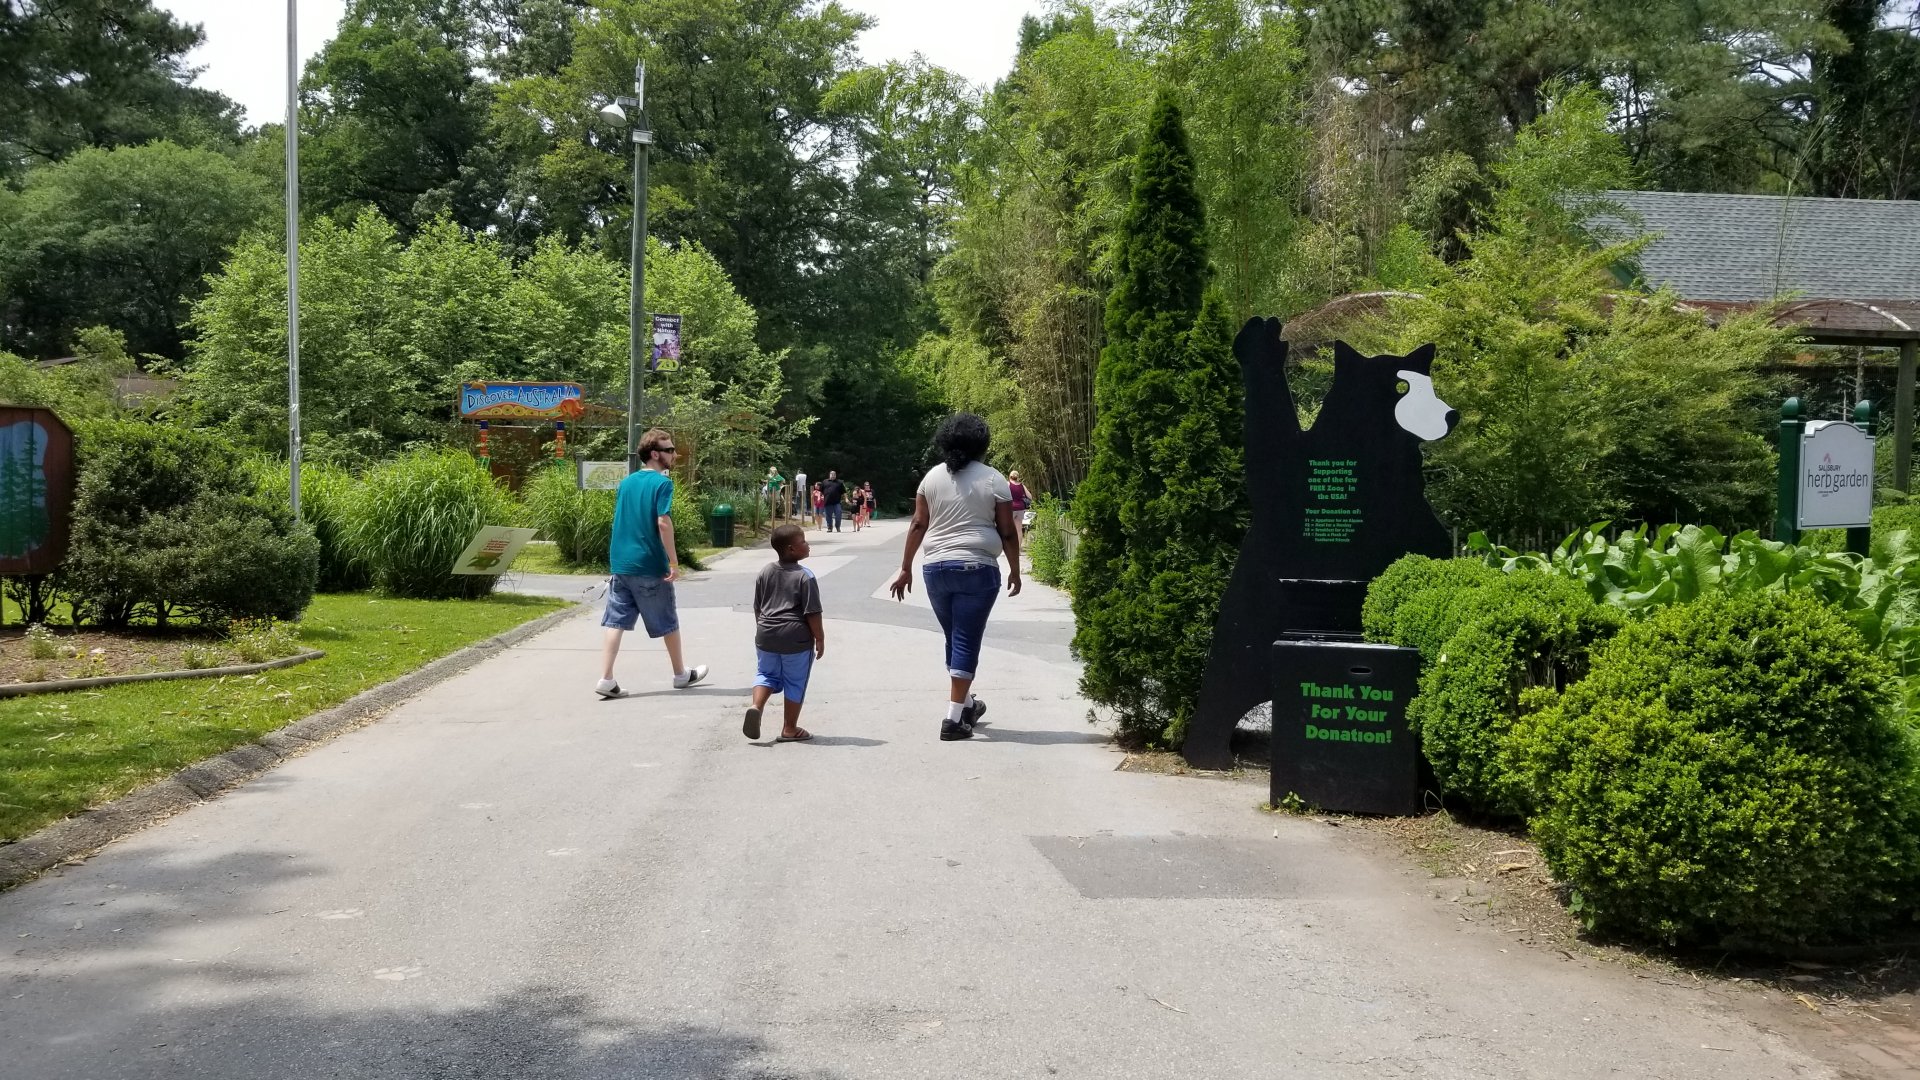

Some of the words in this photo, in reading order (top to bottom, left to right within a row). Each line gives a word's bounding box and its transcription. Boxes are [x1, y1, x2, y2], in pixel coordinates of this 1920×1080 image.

[1313, 468, 1353, 476] Supporting
[1331, 460, 1345, 468] you
[1346, 459, 1358, 467] for
[1309, 484, 1326, 492] FREE
[1348, 484, 1356, 492] in
[1807, 469, 1832, 488] herb
[1833, 469, 1868, 492] garden
[1300, 682, 1355, 699] Thank
[1360, 685, 1393, 702] You
[1311, 704, 1340, 719] For
[1345, 706, 1388, 722] Your
[1305, 724, 1392, 744] Donation!
